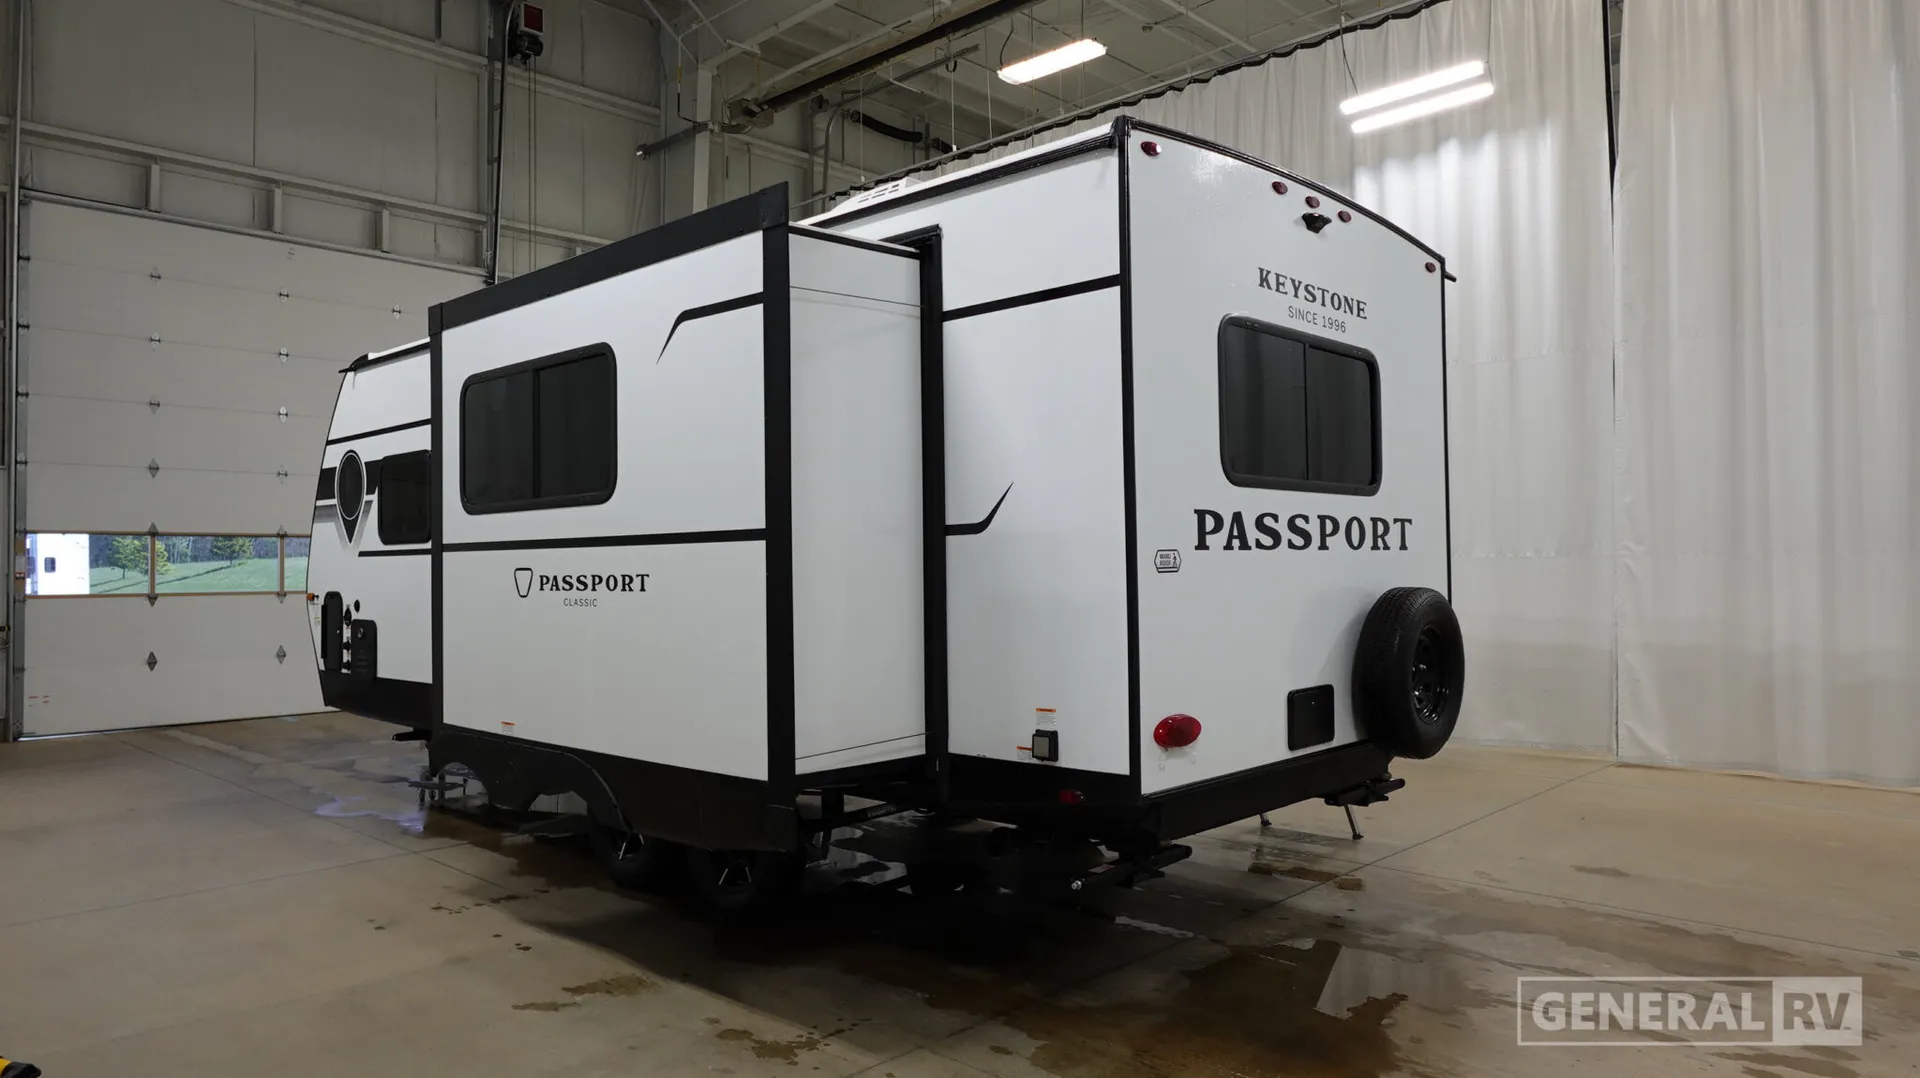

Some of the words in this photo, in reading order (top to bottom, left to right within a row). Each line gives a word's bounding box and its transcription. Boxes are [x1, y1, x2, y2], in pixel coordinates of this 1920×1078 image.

[1258, 267, 1367, 320] KEYSTONE
[1288, 305, 1318, 326] SINCE
[1322, 316, 1346, 333] 1996
[1194, 508, 1412, 551] PASSPORT
[539, 574, 650, 592] PASSPORT
[563, 598, 598, 607] CLASSIC
